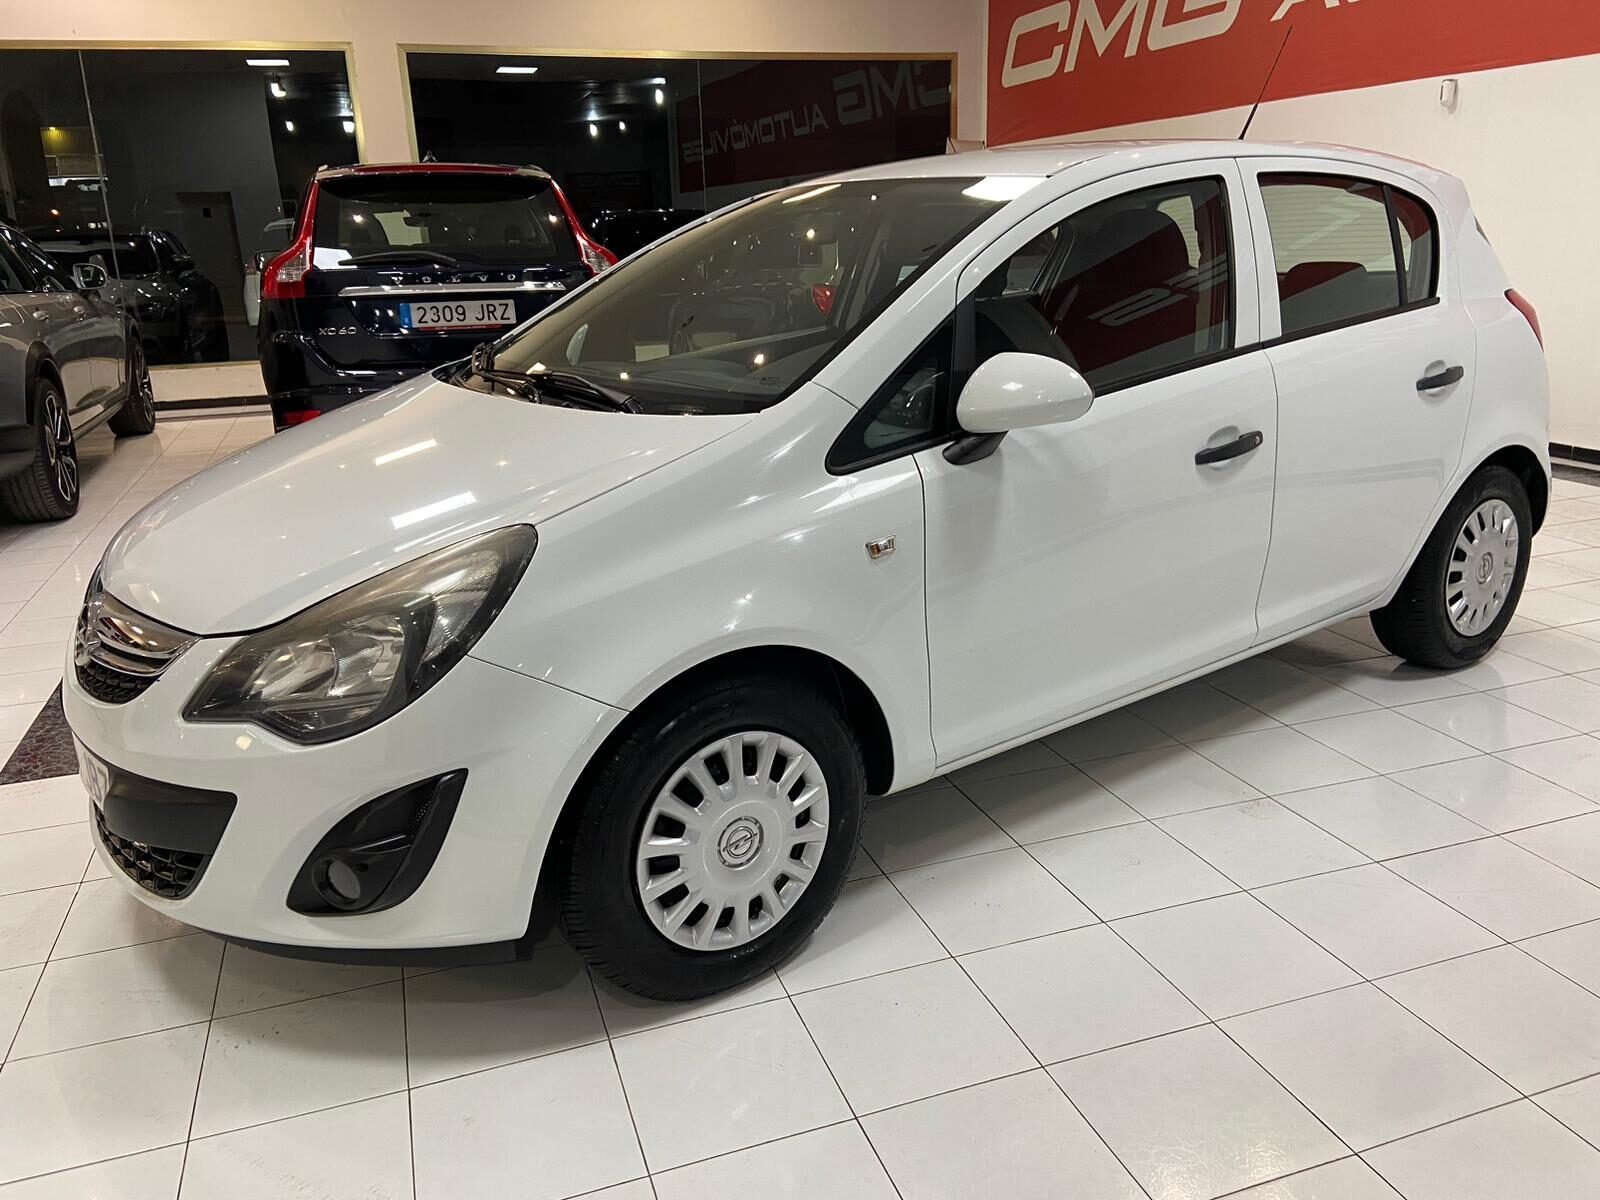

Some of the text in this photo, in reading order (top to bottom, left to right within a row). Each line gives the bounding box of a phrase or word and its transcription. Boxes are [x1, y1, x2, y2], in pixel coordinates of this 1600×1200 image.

[391, 273, 515, 284] VOLVO
[416, 303, 510, 323] 2309 JRZ
[318, 326, 357, 336] XC60
